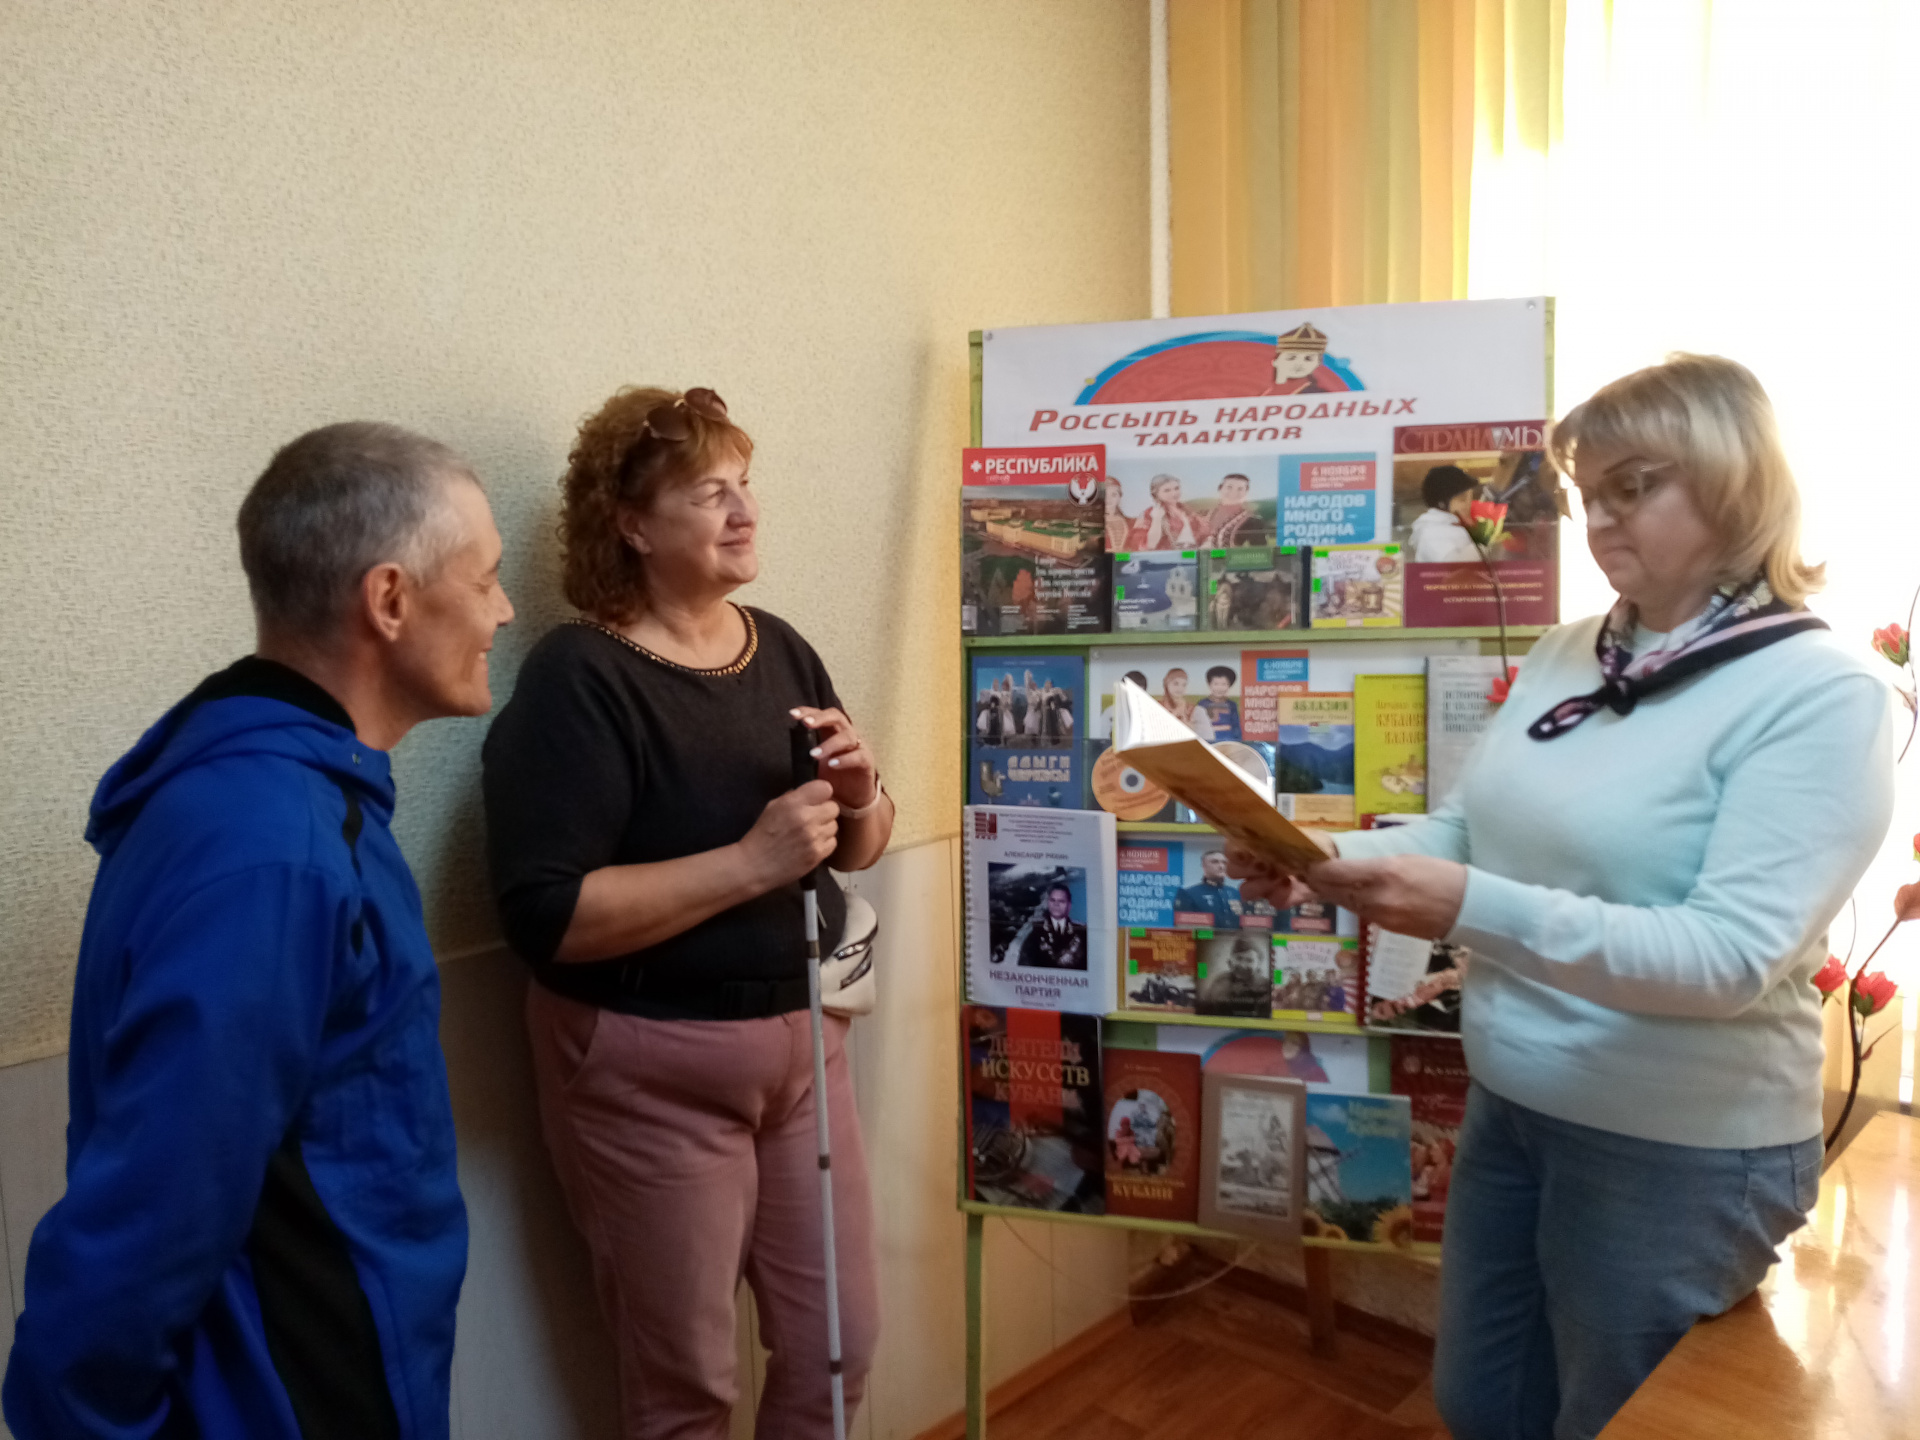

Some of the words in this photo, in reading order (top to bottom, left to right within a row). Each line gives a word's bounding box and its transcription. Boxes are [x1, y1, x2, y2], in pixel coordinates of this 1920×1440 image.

[1029, 409, 1198, 432] РОССЫПЬ
[1214, 397, 1418, 424] НАРОДНЫХ
[1134, 426, 1304, 446] ТАЛАНТОВ
[985, 455, 1099, 474] РЕСПУБЛИКА
[1321, 465, 1367, 476] НОЯБРЯ
[1284, 494, 1366, 508] НАРОДОВ
[1284, 509, 1344, 523] МНОГО
[1283, 523, 1355, 538] РОДИНА
[1244, 697, 1277, 708] МНОГ
[1008, 755, 1070, 769] АДЫГИ
[1119, 873, 1181, 887] НАРОДОВ
[1119, 885, 1164, 898] МНОГО
[1119, 896, 1173, 910] РОДИНА
[1119, 908, 1159, 921] ОДНА!
[989, 970, 1088, 988] НЕЗАКОНЧЕННАЯ
[1015, 985, 1061, 999] ПАРТИЯ
[981, 1057, 1090, 1087] ИСКУССТВ
